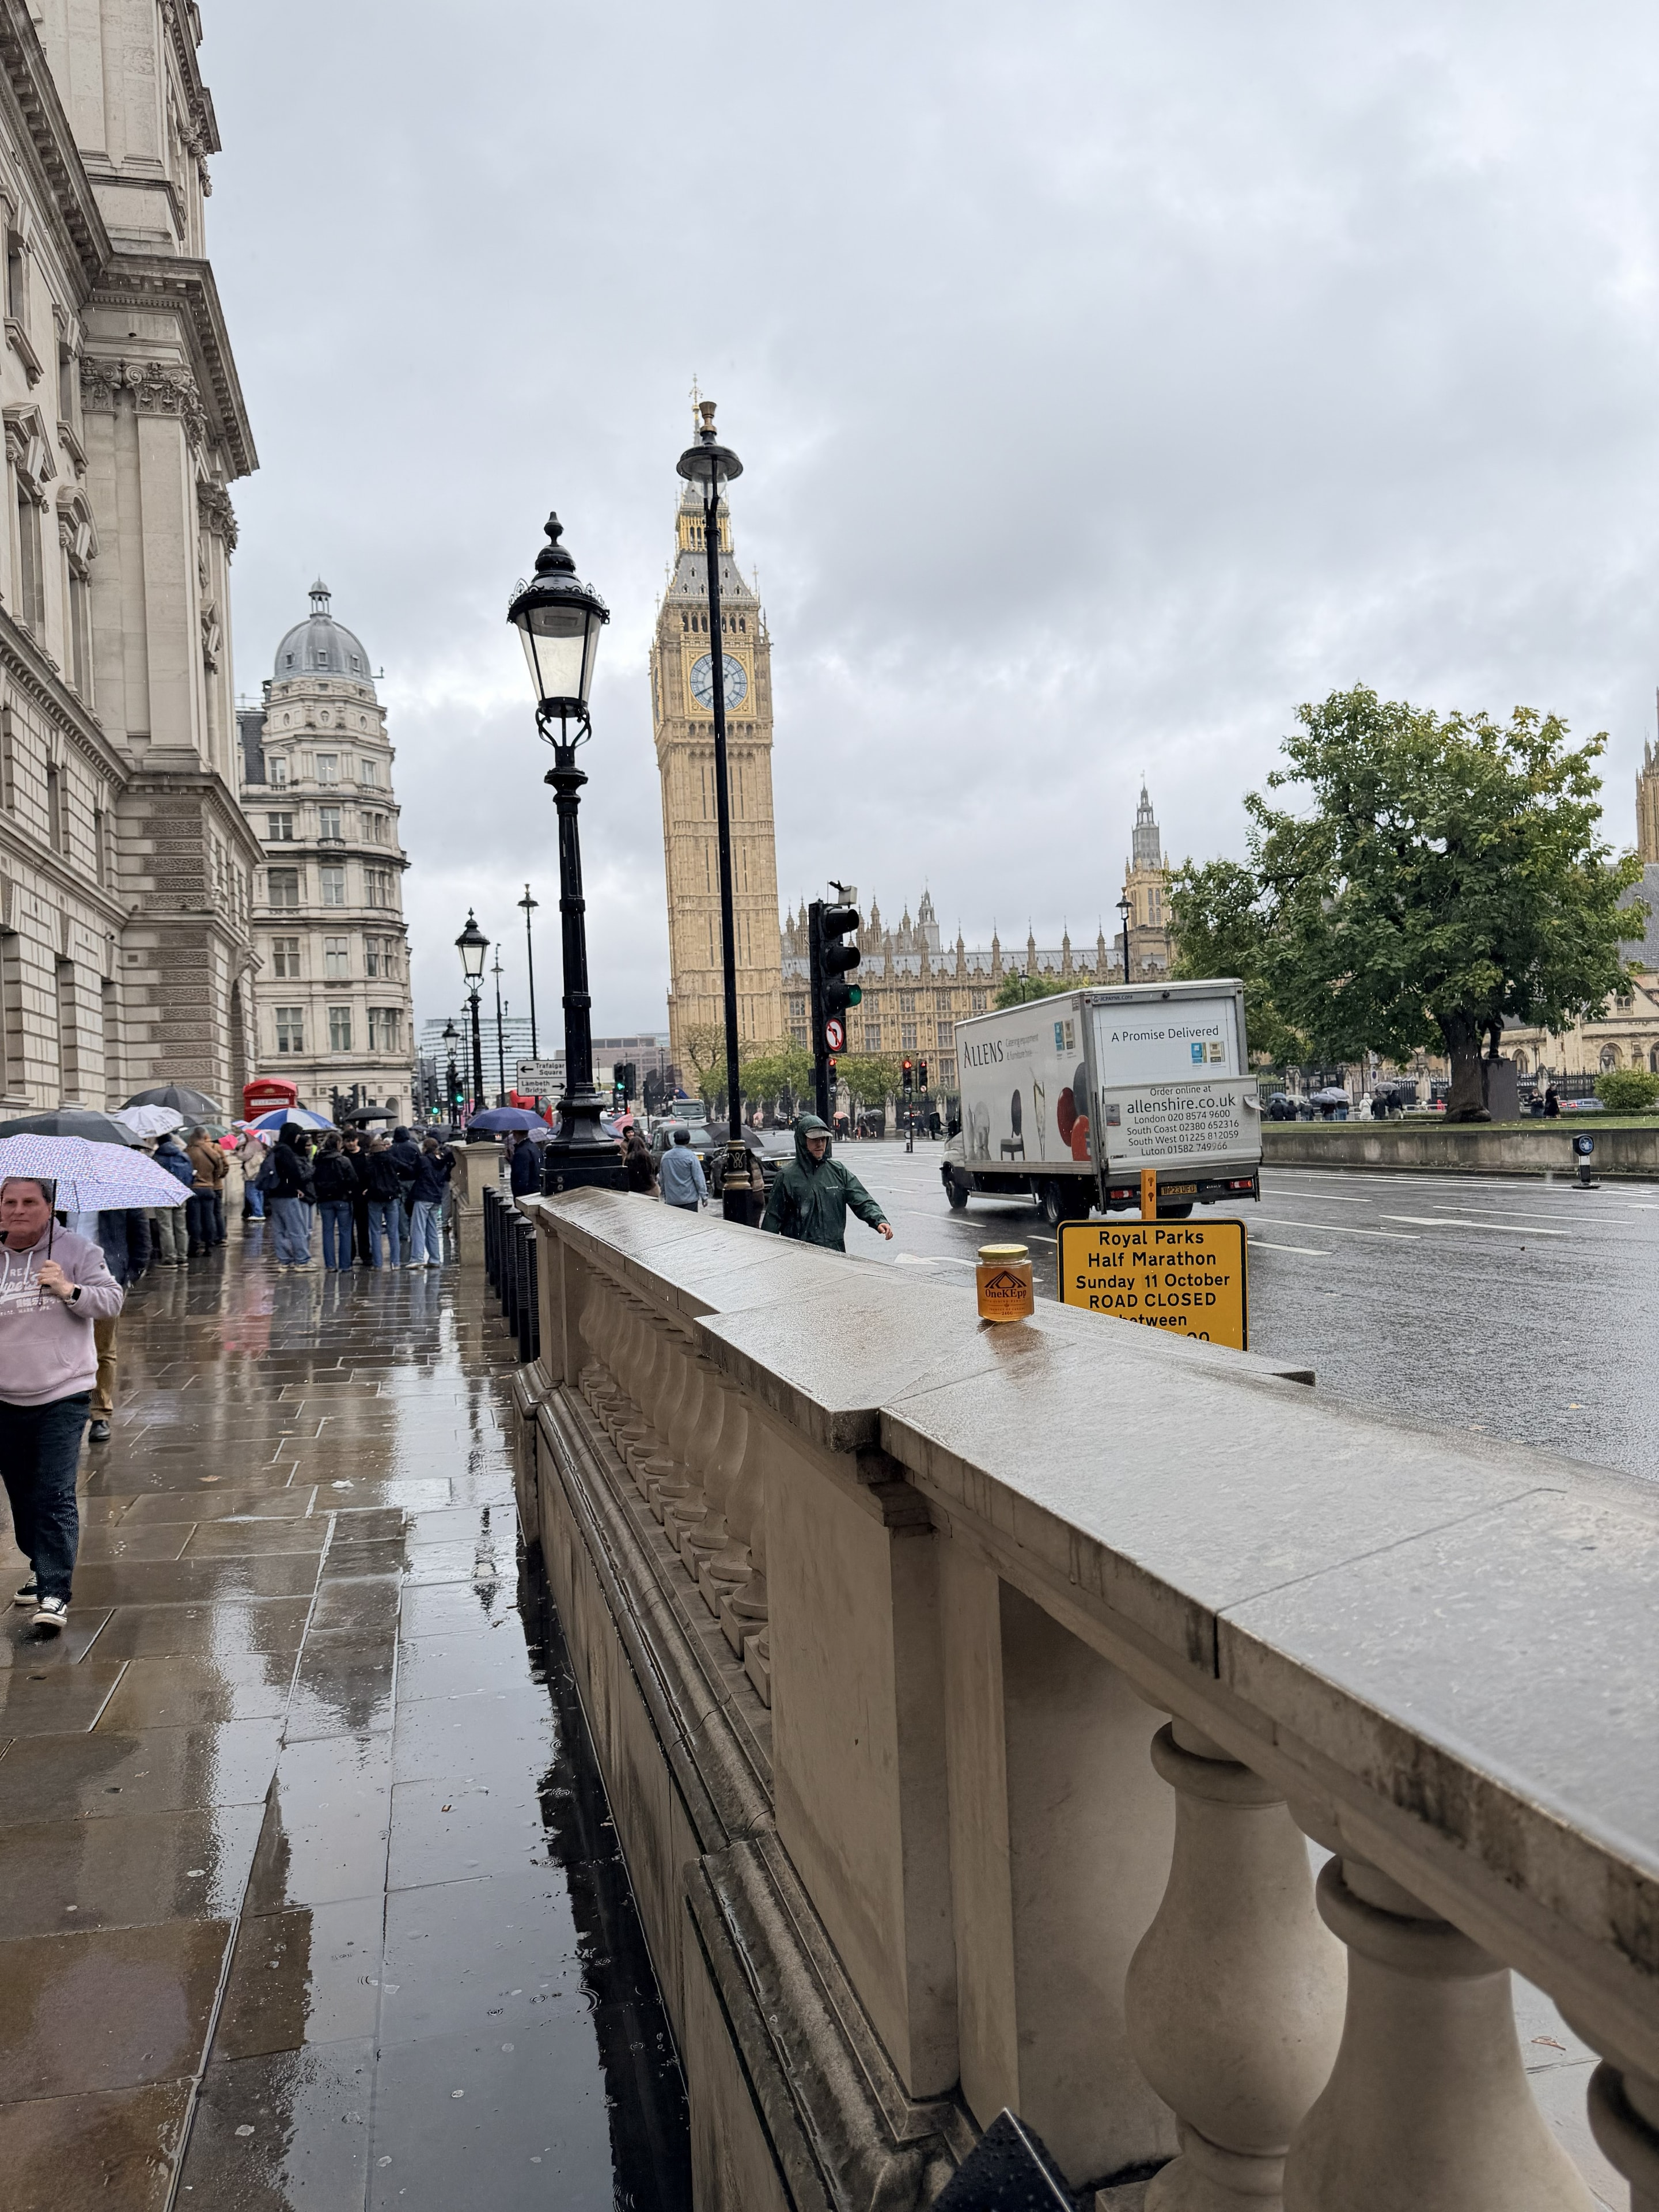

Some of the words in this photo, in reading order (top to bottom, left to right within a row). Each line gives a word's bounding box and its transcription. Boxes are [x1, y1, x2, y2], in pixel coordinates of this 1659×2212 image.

[1111, 1032, 1119, 1042] A
[1123, 1029, 1165, 1041] Promise
[1168, 1025, 1218, 1039] Delivered
[964, 1040, 1003, 1069] ALLENS
[1150, 1087, 1173, 1096] Order
[1176, 1085, 1200, 1094] online
[1127, 1093, 1236, 1113] allenshire.co.uk
[1134, 1115, 1165, 1124] London
[1168, 1113, 1183, 1122] 020
[1185, 1111, 1206, 1120] 8574
[1209, 1109, 1230, 1118] 9600
[1127, 1126, 1152, 1135] South
[1154, 1124, 1177, 1133] Coast
[1179, 1122, 1205, 1132] 02380
[1208, 1120, 1239, 1130] 652316
[1128, 1137, 1153, 1146] South
[1156, 1135, 1177, 1143] West
[1179, 1133, 1205, 1142] 01225
[1208, 1130, 1238, 1140] 812059
[1141, 1147, 1165, 1156] Luton
[1167, 1144, 1194, 1153] 01582
[1099, 1230, 1147, 1248] Royal
[1155, 1230, 1204, 1244] Parks
[1088, 1252, 1124, 1267] Half
[1132, 1251, 1216, 1266] Marathon
[1075, 1275, 1135, 1290] Sunday
[1144, 1274, 1157, 1287] 11
[1164, 1273, 1230, 1287] October
[985, 1289, 1027, 1299] OneKEpp
[1089, 1294, 1138, 1309] ROAD
[1144, 1292, 1216, 1307] CLOSED
